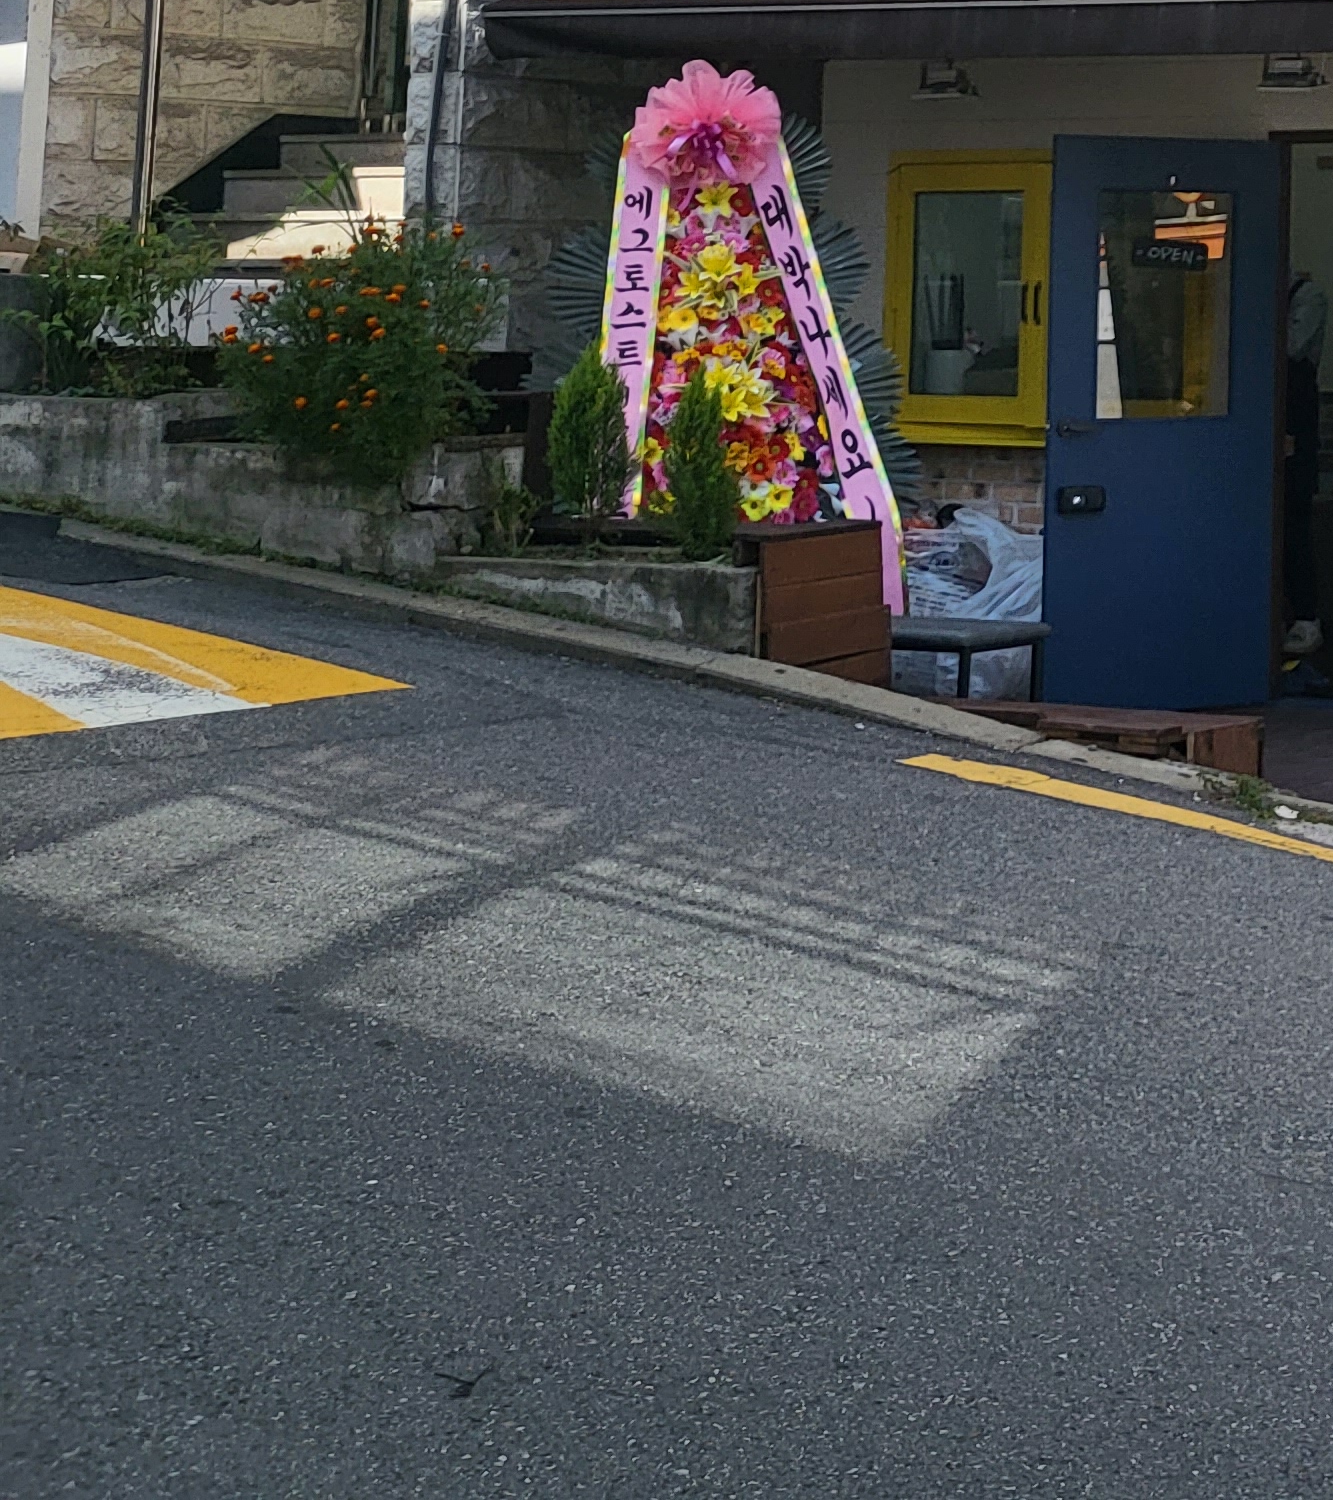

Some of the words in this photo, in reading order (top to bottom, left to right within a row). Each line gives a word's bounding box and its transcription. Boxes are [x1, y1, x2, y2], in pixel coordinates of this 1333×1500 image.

[611, 186, 654, 367] 에그토스트
[761, 185, 873, 480] 대박나세요
[1147, 246, 1195, 264] OPEN
